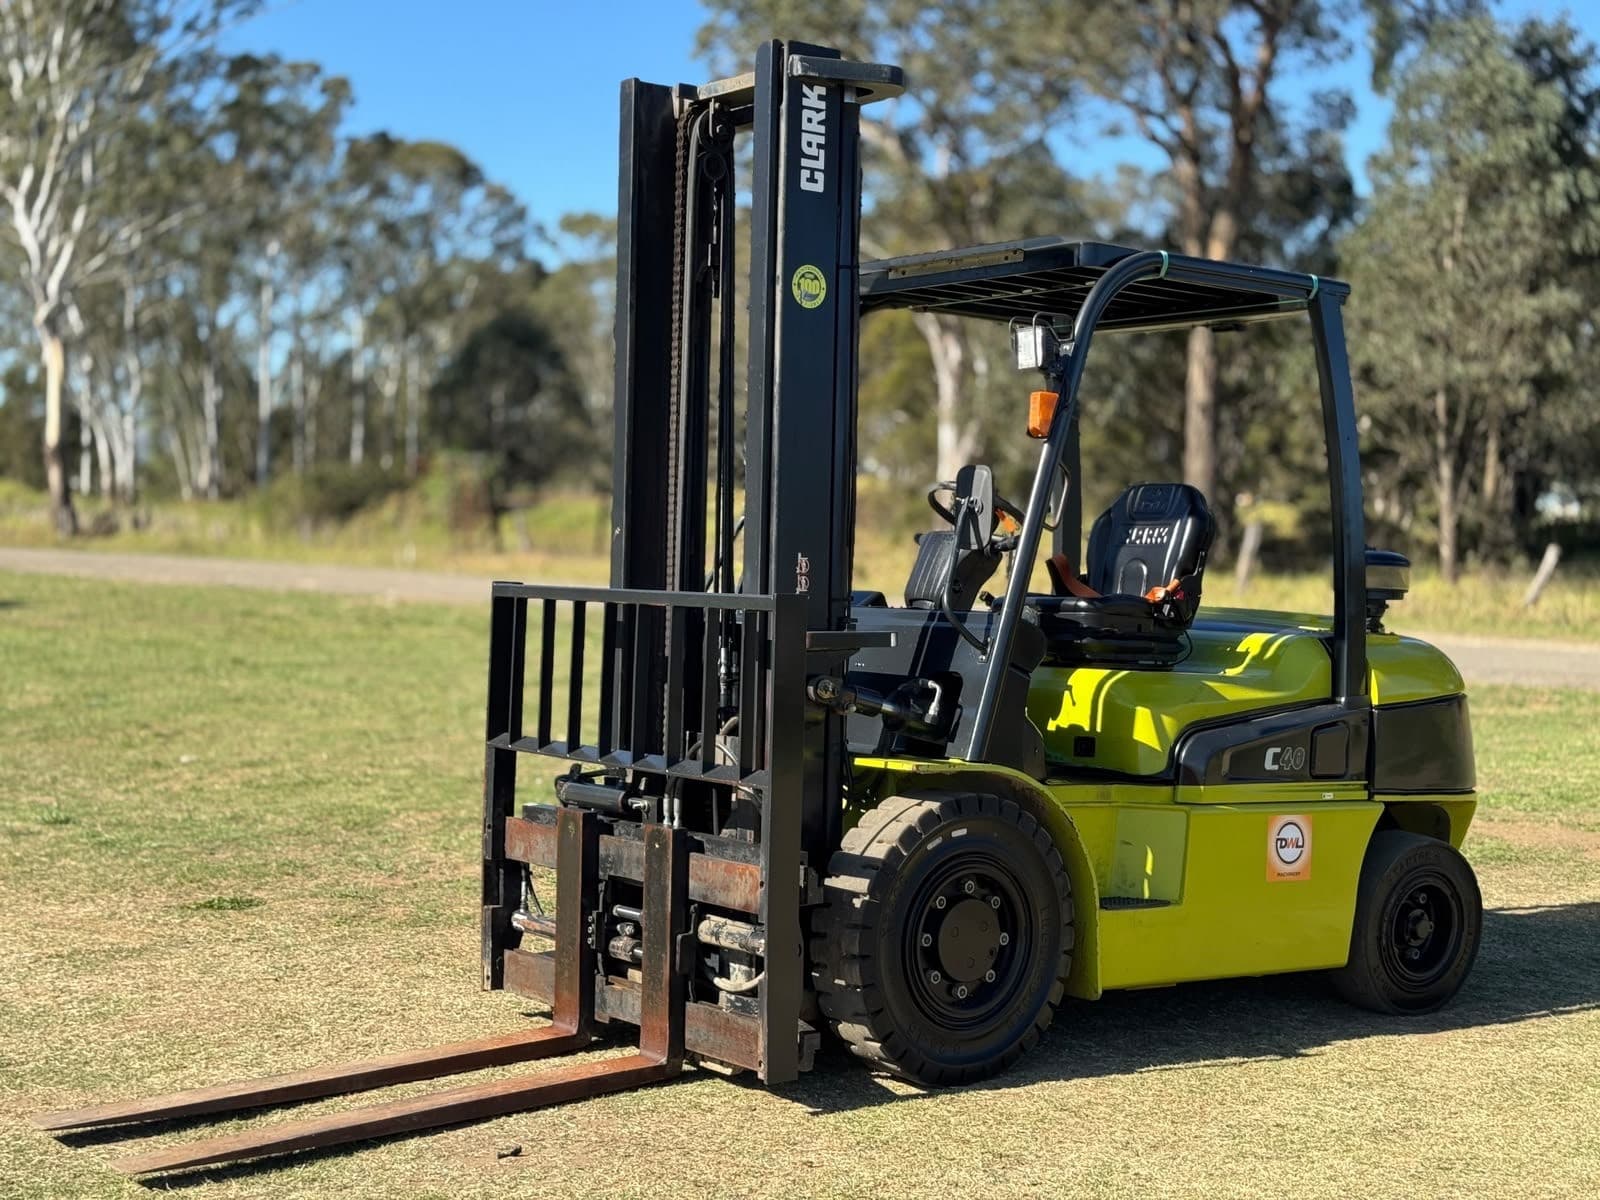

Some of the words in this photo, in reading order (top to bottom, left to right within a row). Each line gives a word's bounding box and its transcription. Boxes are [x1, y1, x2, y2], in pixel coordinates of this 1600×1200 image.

[800, 83, 827, 193] CLARK
[1264, 747, 1306, 771] C40
[1276, 837, 1304, 849] DWL
